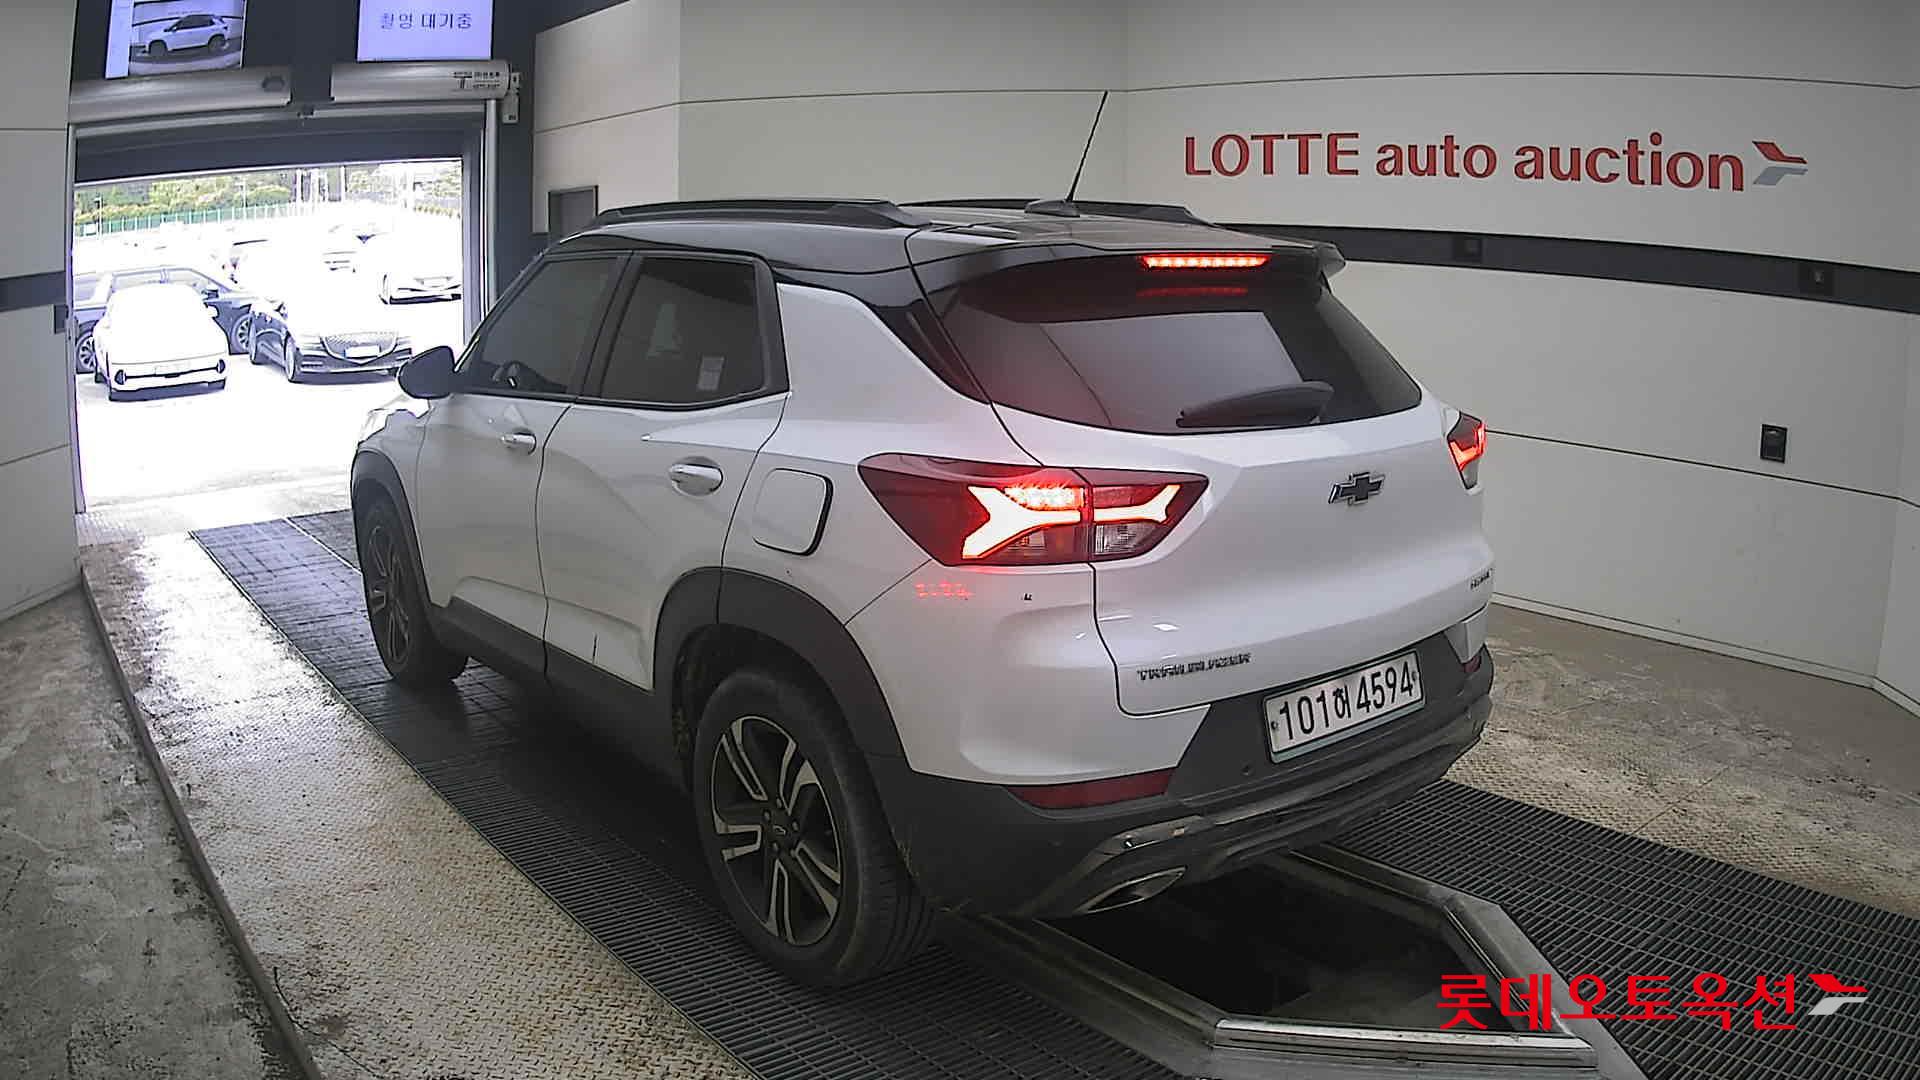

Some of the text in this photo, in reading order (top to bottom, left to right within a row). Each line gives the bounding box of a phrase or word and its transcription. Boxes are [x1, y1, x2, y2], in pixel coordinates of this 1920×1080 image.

[421, 13, 472, 29] 대기중
[1185, 131, 1745, 191] LOTTE auto auction
